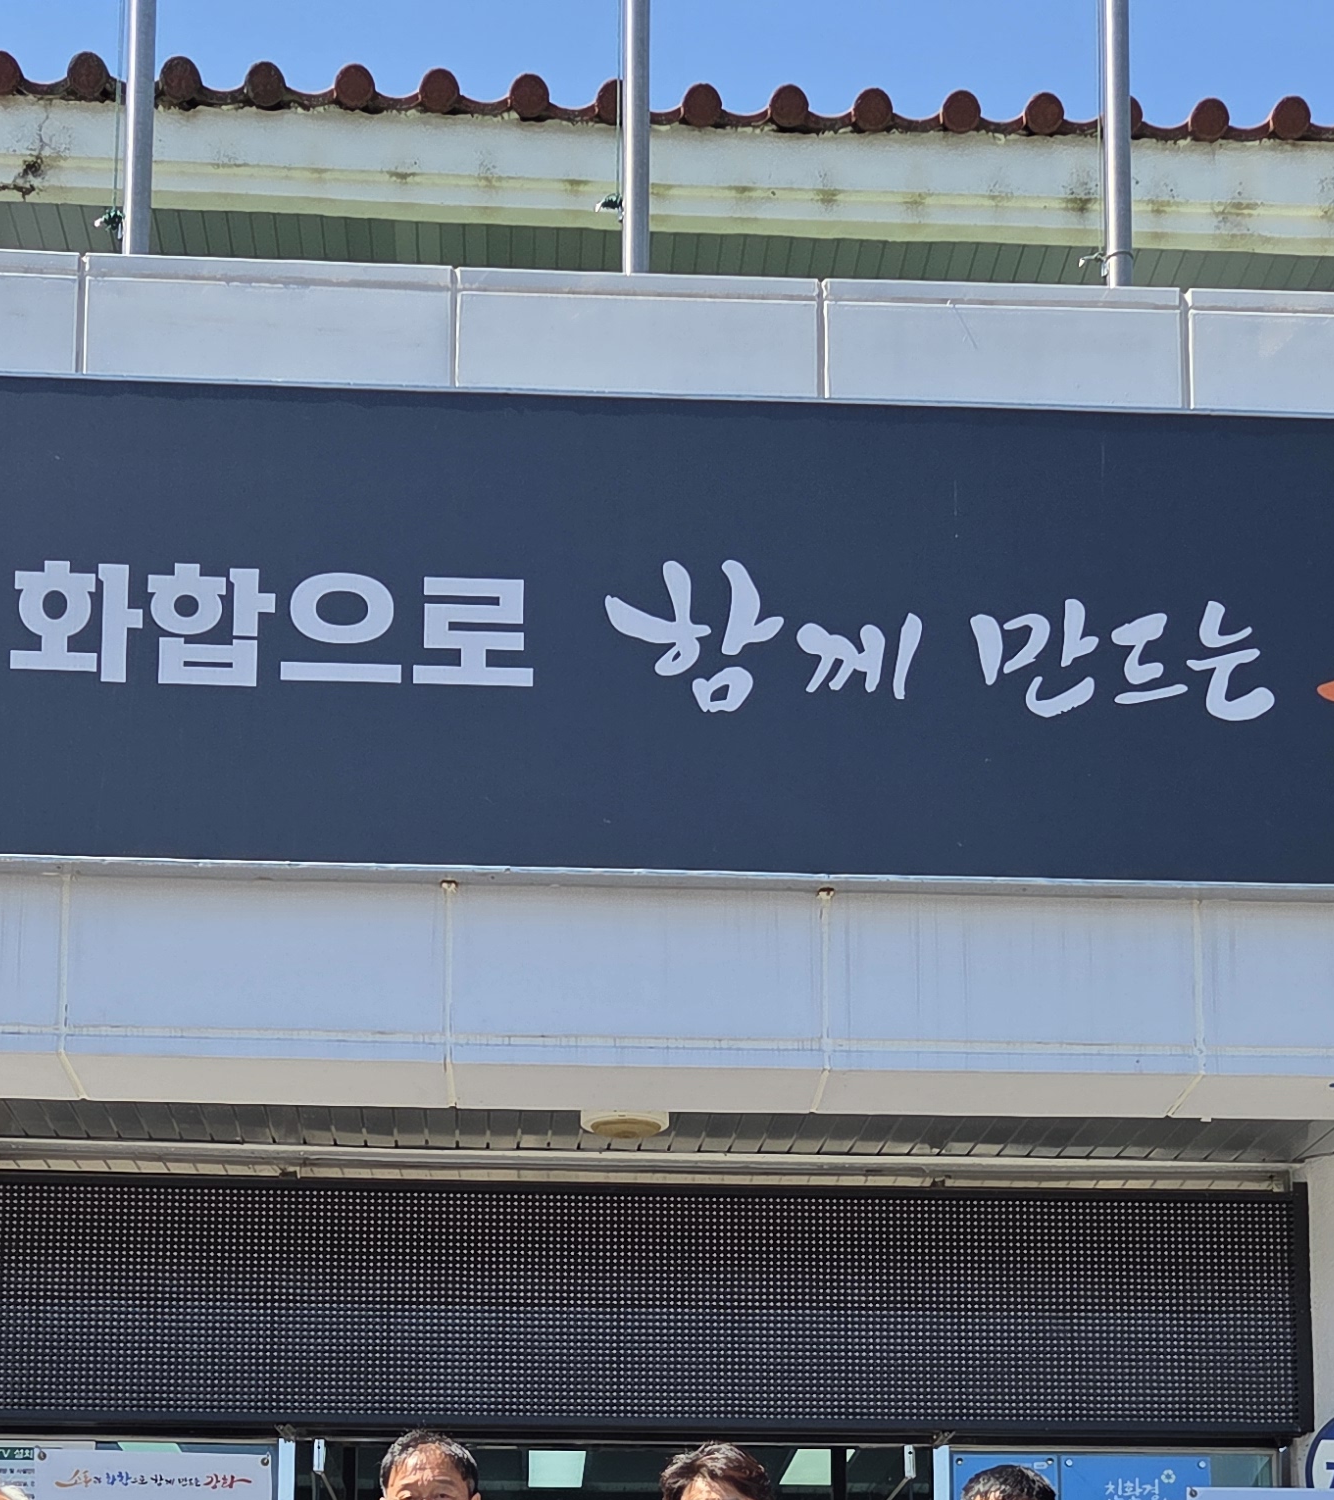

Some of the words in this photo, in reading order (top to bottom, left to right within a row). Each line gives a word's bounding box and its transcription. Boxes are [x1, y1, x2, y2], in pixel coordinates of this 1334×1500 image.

[10, 560, 534, 687] 화합으로
[606, 559, 923, 714] 함께
[970, 598, 1276, 720] 만드는
[55, 1468, 103, 1489] 소통과
[105, 1470, 149, 1487] 화합으로
[150, 1474, 175, 1487] 함께
[203, 1473, 253, 1490] 강화
[1104, 1477, 1160, 1500] 친환경
